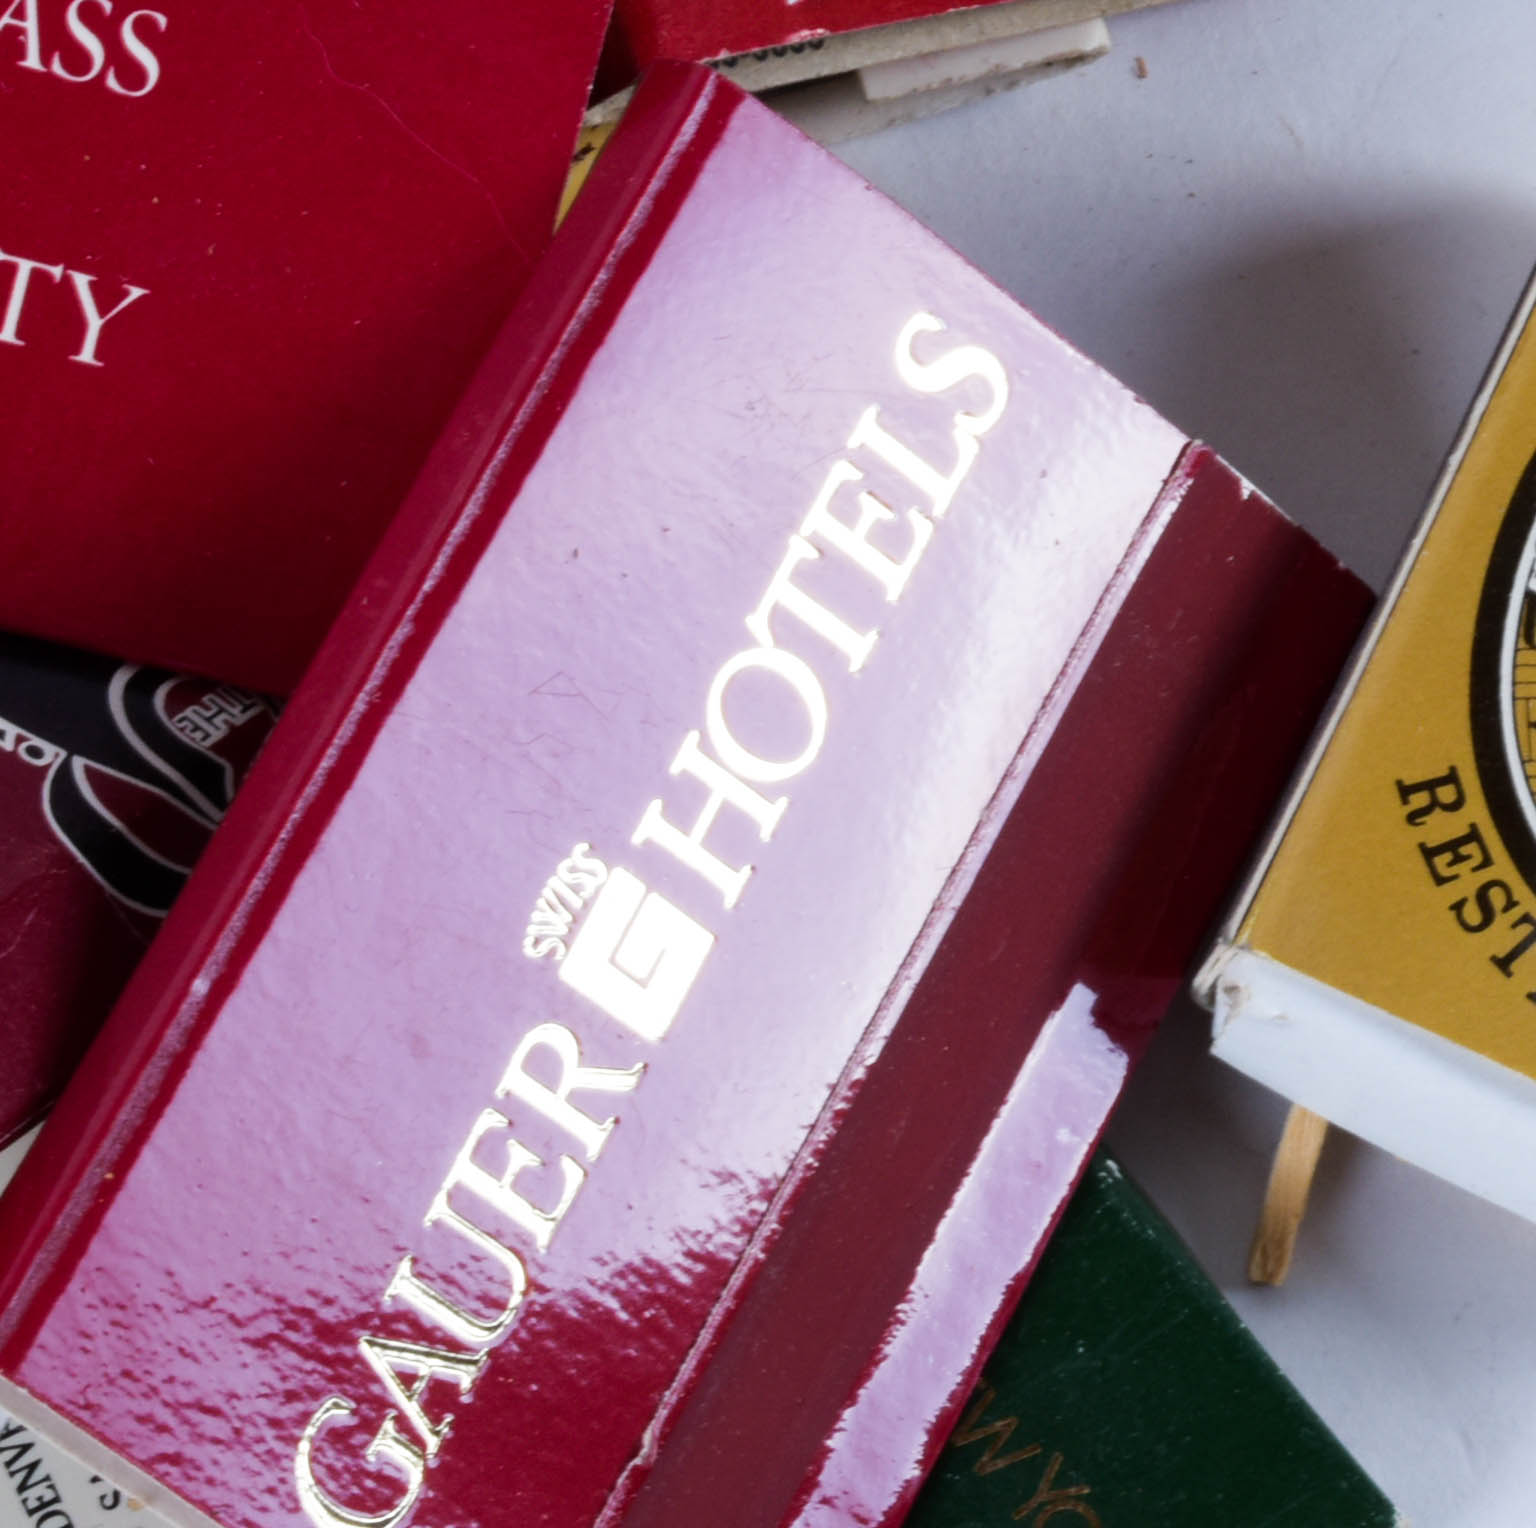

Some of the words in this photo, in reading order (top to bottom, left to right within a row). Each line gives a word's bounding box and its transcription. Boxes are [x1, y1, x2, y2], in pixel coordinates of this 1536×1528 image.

[294, 1022, 650, 1528] GAUER
[631, 309, 1010, 911] HOTELS
[522, 840, 612, 962] SWISS
